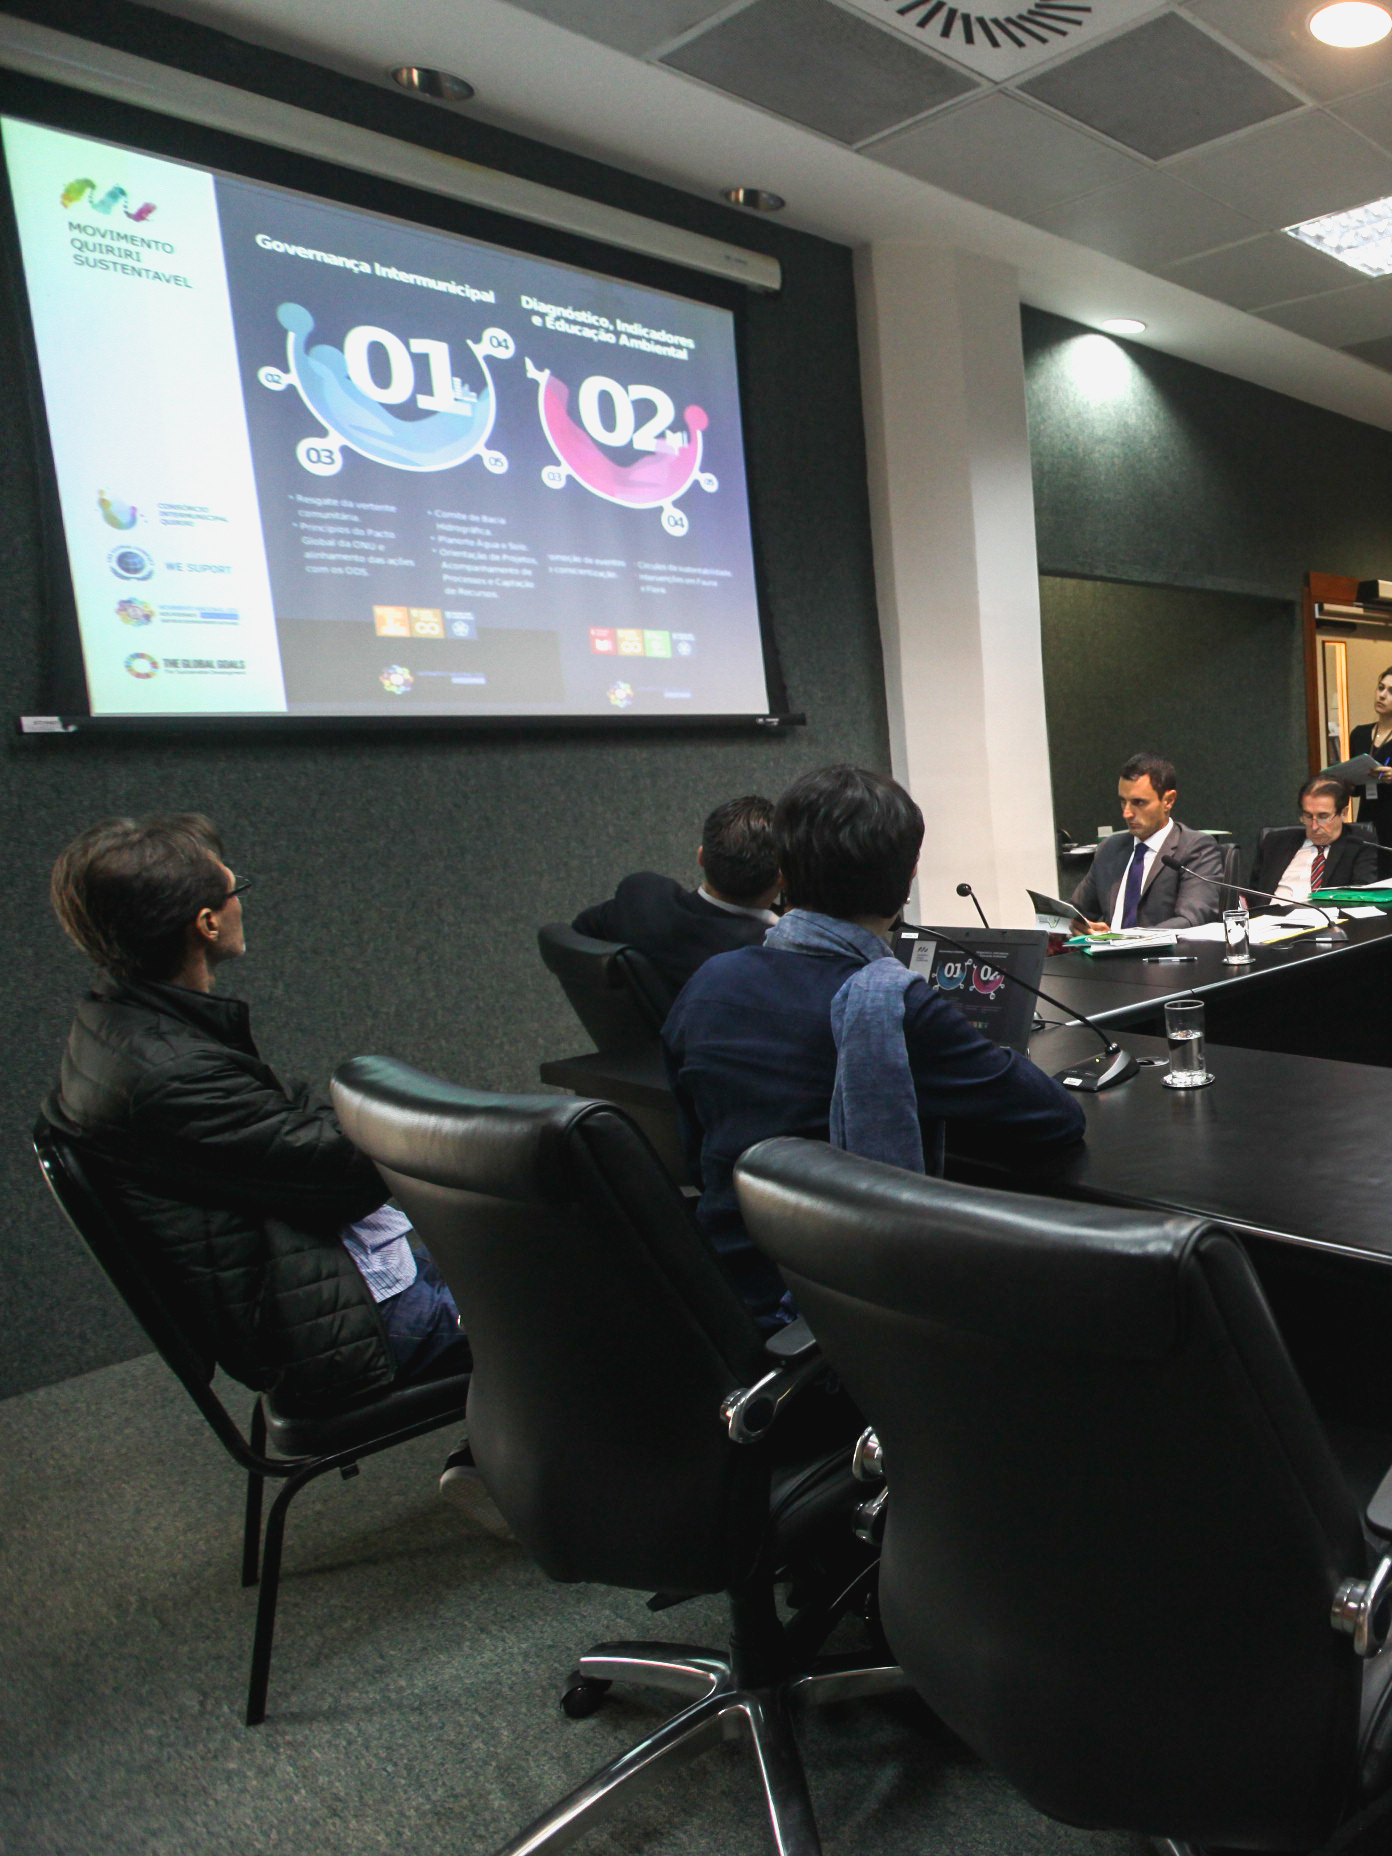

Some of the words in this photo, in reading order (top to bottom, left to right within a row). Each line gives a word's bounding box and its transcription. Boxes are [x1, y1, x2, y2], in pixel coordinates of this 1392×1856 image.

[67, 221, 175, 254] MOVIMENTO
[70, 237, 142, 263] QUIRIRI
[72, 253, 195, 289] SUSTENTAVEL
[255, 233, 372, 274] Governança
[374, 262, 496, 304] Intermunicipal
[521, 294, 614, 331] Diagnóstico,
[616, 318, 696, 349] Indicadores
[531, 314, 543, 327] e
[545, 315, 616, 344] Educação
[619, 333, 689, 360] Ambiental
[489, 335, 509, 351] 04
[344, 325, 473, 417] 01
[578, 375, 680, 456] 02
[305, 446, 336, 467] 03
[667, 515, 685, 529] 04
[162, 658, 178, 669] THE
[181, 658, 216, 669] GLOBAL
[216, 659, 246, 670] GOALS
[944, 962, 962, 978] 01
